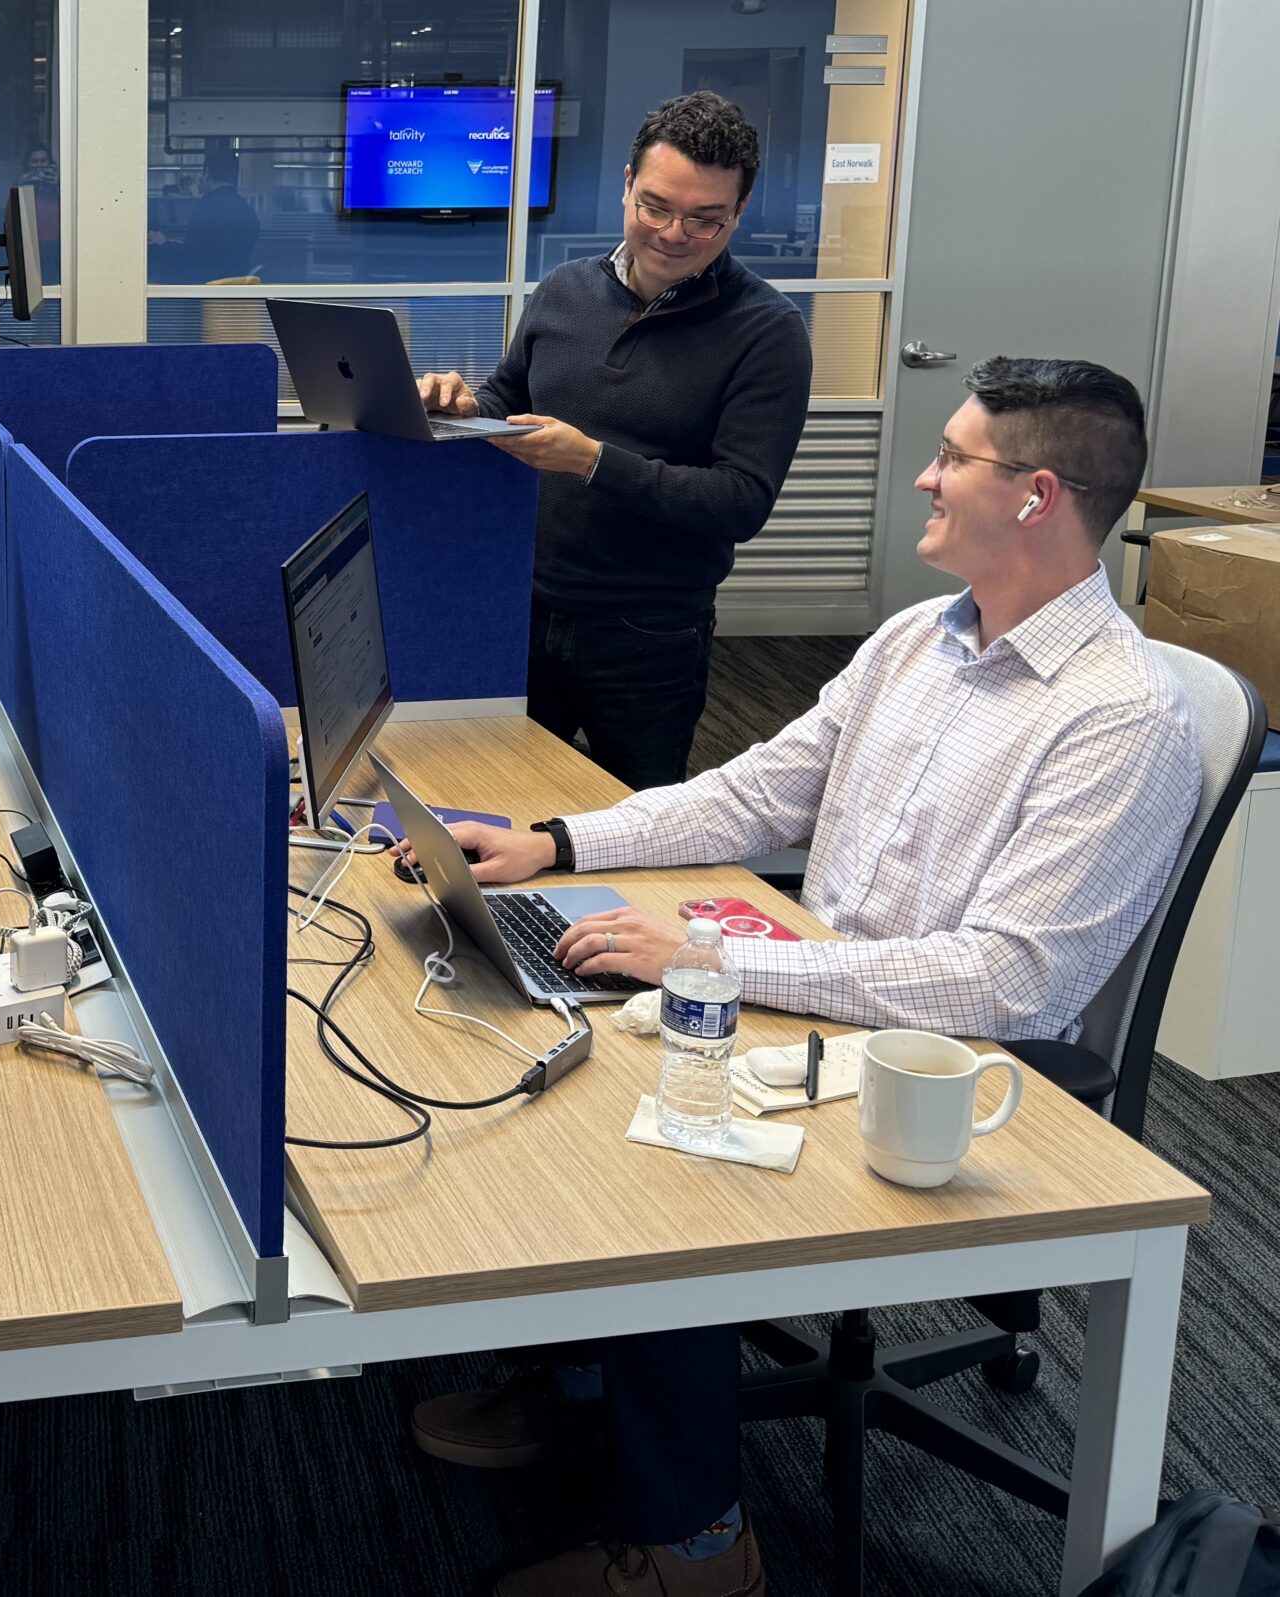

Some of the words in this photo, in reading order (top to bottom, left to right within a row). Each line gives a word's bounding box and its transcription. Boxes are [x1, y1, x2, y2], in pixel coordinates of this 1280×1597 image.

[389, 127, 426, 142] talivity
[468, 126, 510, 140] recruitics
[387, 160, 424, 168] ONWARD
[832, 160, 846, 169] East
[847, 159, 874, 169] Norwalk
